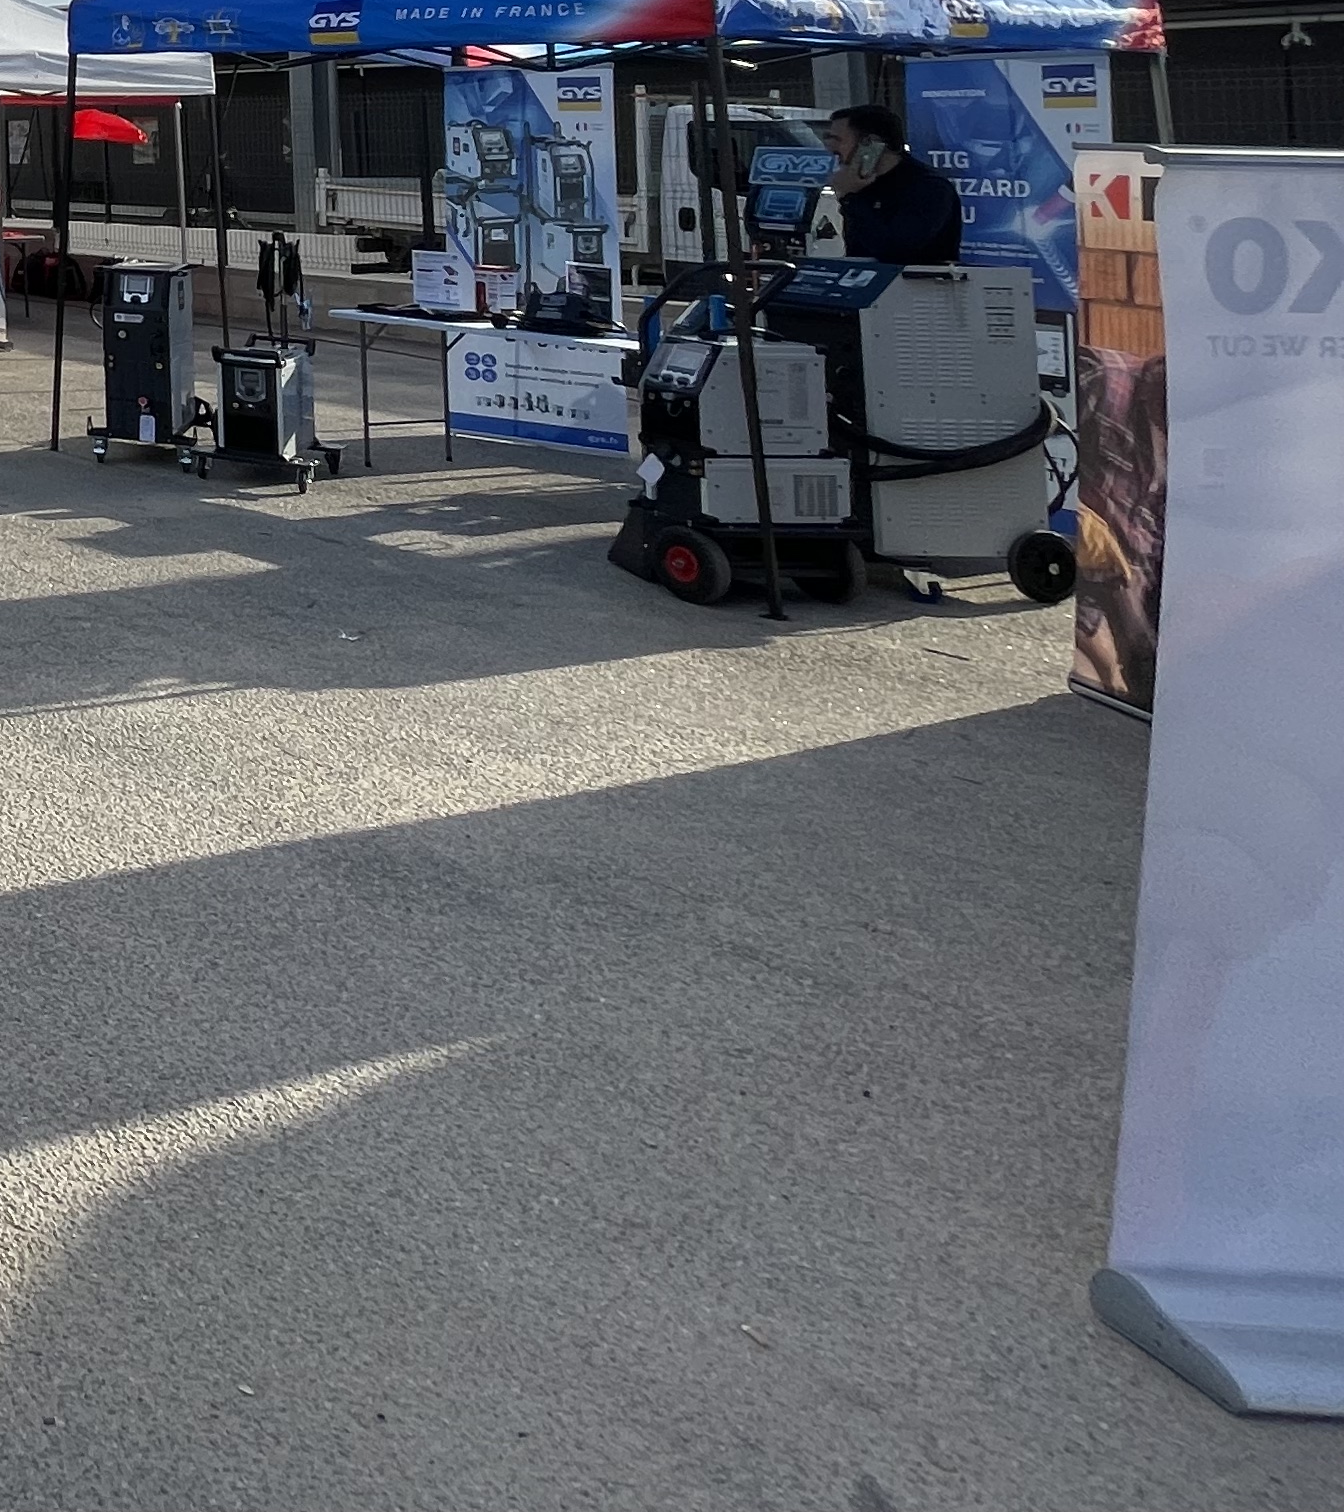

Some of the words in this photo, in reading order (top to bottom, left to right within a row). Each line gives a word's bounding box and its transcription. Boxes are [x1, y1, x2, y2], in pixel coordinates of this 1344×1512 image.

[308, 11, 361, 29] GYS
[395, 7, 450, 21] MADE
[461, 6, 484, 19] IN
[494, 2, 587, 19] FRANCE
[558, 87, 602, 100] GYS
[1043, 77, 1096, 93] GYS
[928, 151, 969, 169] TIG
[953, 179, 1030, 198] IZARD
